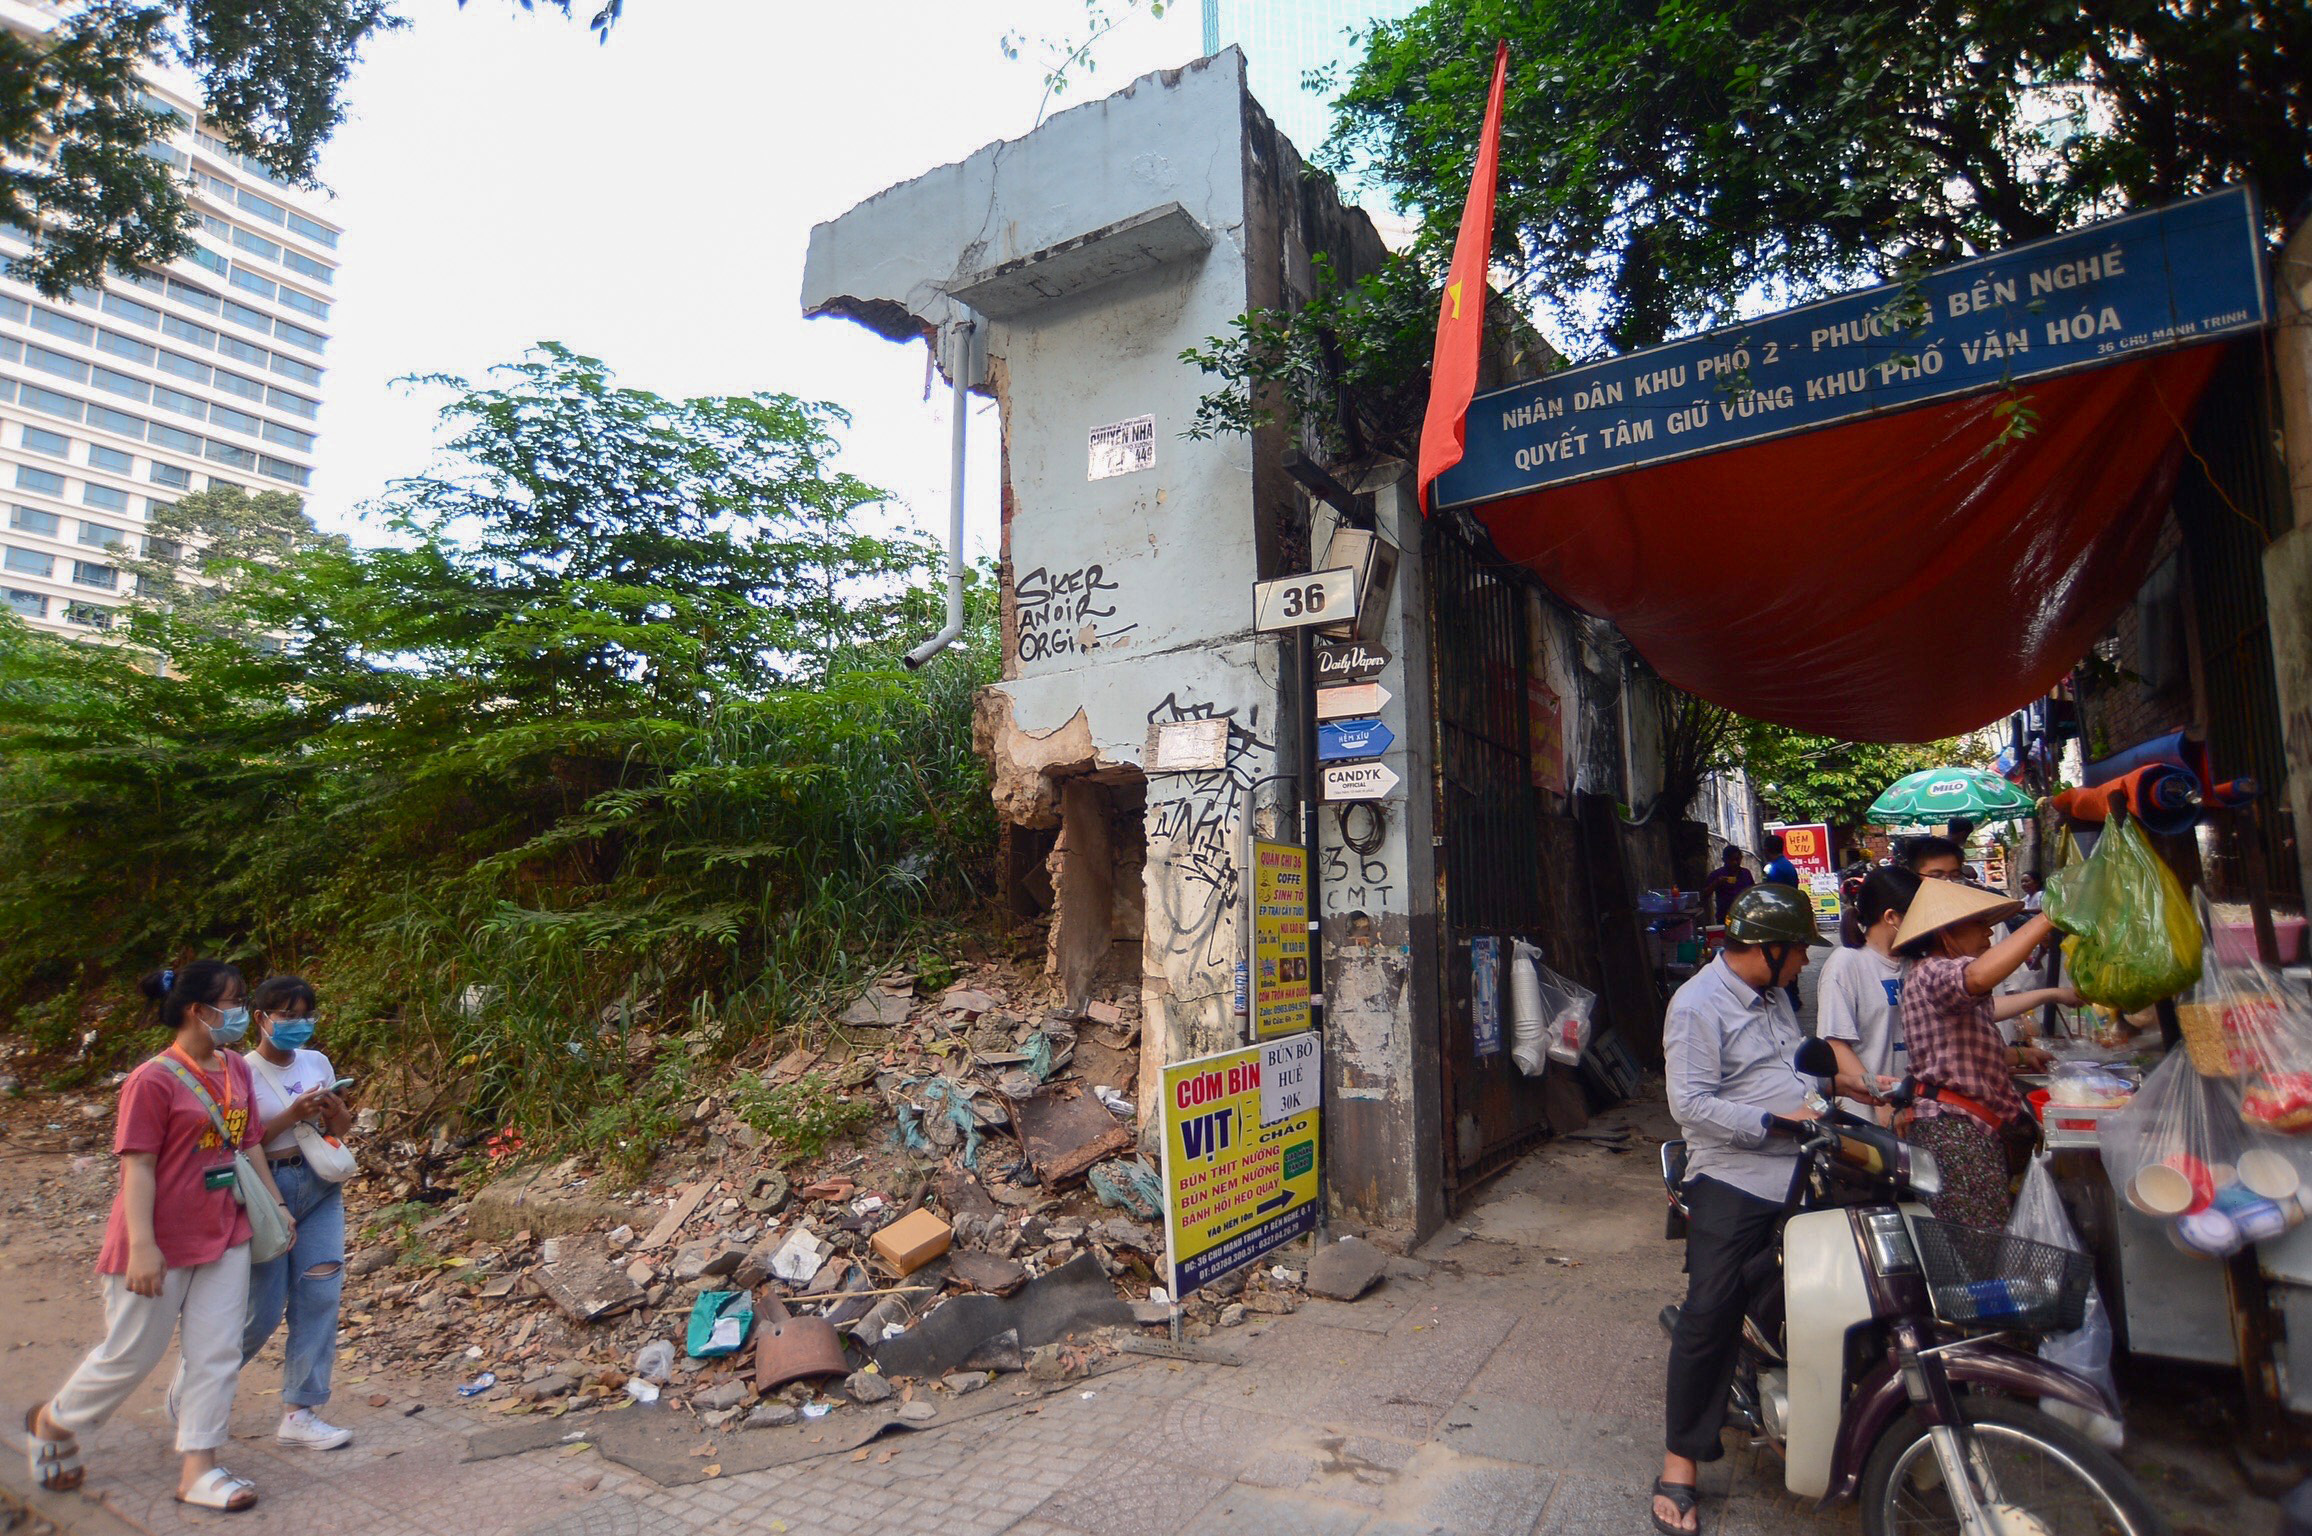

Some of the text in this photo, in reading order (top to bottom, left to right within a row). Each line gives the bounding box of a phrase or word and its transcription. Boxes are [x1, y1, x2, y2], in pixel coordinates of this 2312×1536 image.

[1503, 397, 1563, 430] NHÂN
[1575, 381, 1623, 411] DÂN
[1635, 365, 1686, 397] KHU
[1763, 342, 1779, 365] 2
[1948, 271, 2016, 317] BẾN
[2029, 243, 2125, 296] NGHÉ
[2097, 342, 2114, 354] 36
[2119, 334, 2148, 348] CHU
[2202, 310, 2248, 329] TRINH
[1515, 425, 1588, 471] QUYẾT
[1600, 420, 1654, 449] TÂM
[1667, 398, 1709, 434] GIỮ
[1806, 368, 1866, 402] KHU
[1881, 338, 1945, 385] PHỐ
[1961, 328, 2029, 365] VĂN
[2046, 306, 2121, 347] HÓA
[1132, 420, 1153, 442] NHÀ
[1015, 565, 1118, 609] SKER
[1283, 583, 1326, 617] 36
[1318, 651, 1351, 674] Daily
[1329, 769, 1381, 783] CANDYK
[1932, 782, 1964, 794] MILO
[1293, 855, 1302, 868] 36
[1277, 872, 1301, 885] COFFE
[1274, 889, 1293, 901] SINH
[1268, 1039, 1313, 1067] BÚN BÒ
[1176, 1071, 1223, 1109] CƠM
[1280, 1091, 1301, 1112] 30K
[1180, 1108, 1232, 1162] VỊT
[1180, 1145, 1280, 1190] BÚN THỊT NƯỚNG
[1181, 1161, 1280, 1209] BÚN NEM NƯỚNG
[1182, 1206, 1210, 1228] BÁNH
[1234, 1189, 1253, 1206] HEO
[1256, 1178, 1280, 1196] QUAY
[1207, 1224, 1222, 1238] VÀO
[1198, 1256, 1207, 1267] 36
[1208, 1250, 1222, 1264] CHU
